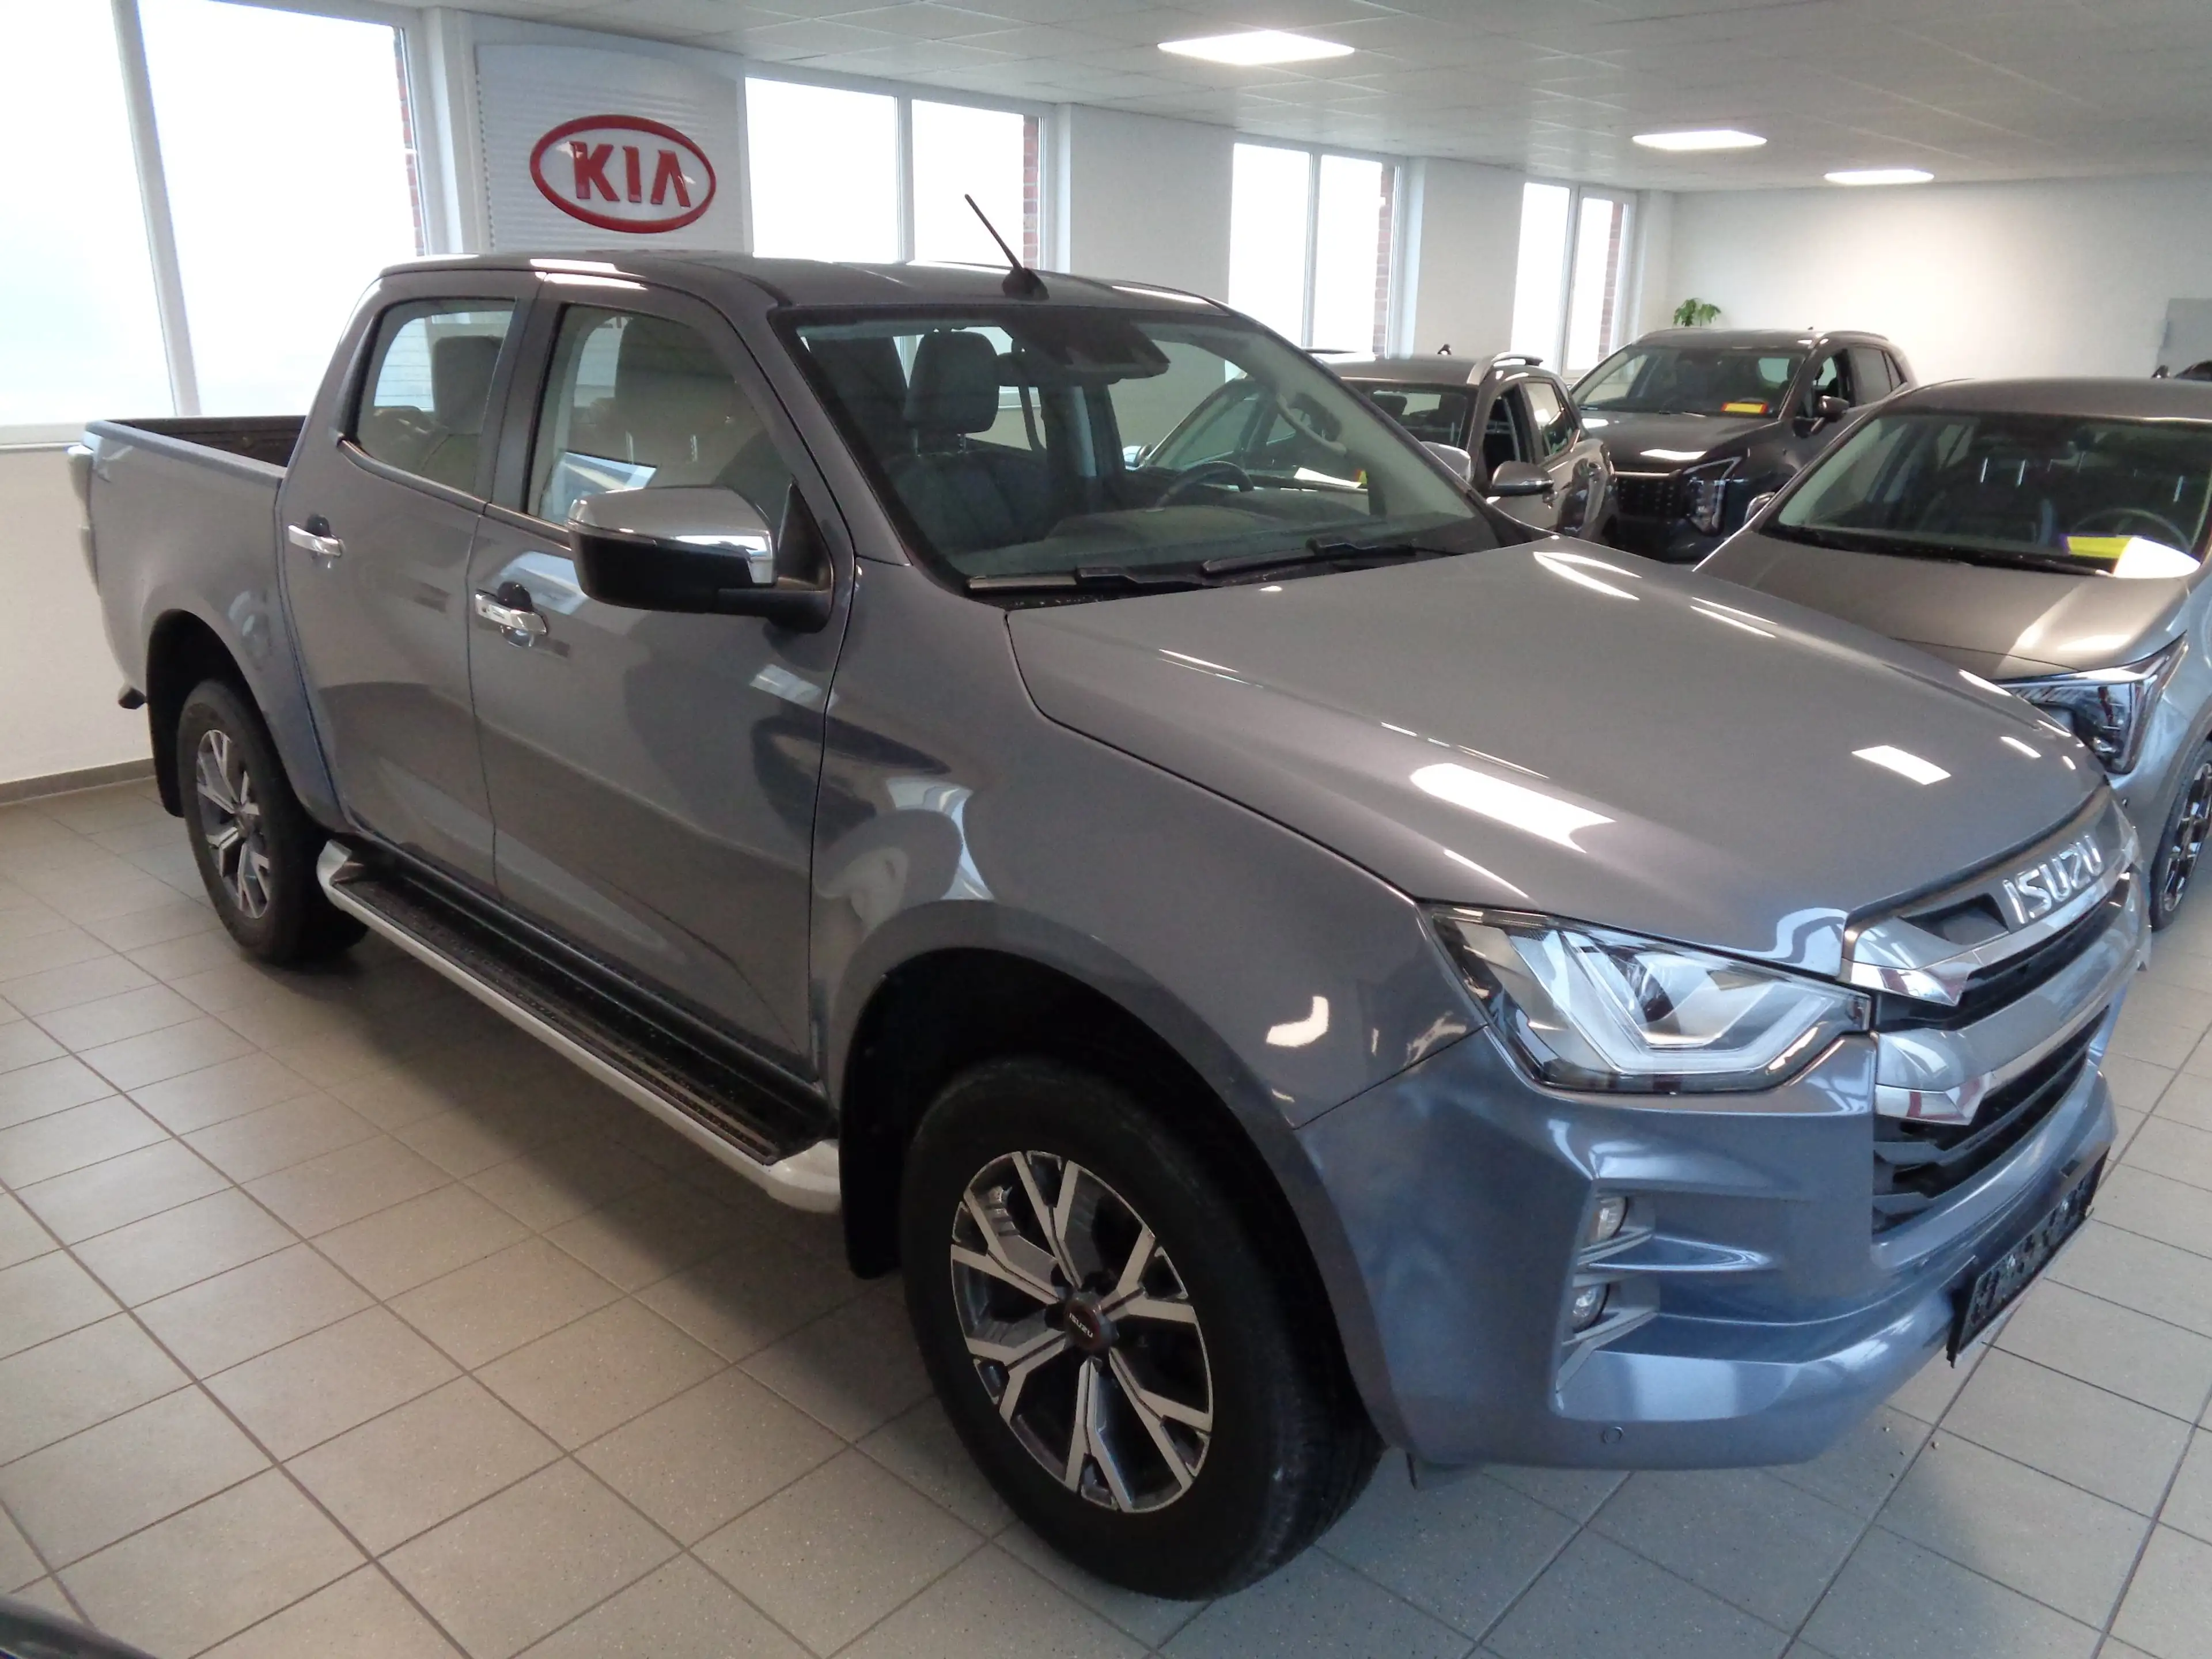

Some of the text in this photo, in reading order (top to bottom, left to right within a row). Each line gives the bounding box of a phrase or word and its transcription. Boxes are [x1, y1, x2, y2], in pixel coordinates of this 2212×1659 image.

[570, 140, 691, 208] KIA
[2002, 835, 2104, 924] ISUZU
[1069, 1312, 1093, 1338] ISUZU
